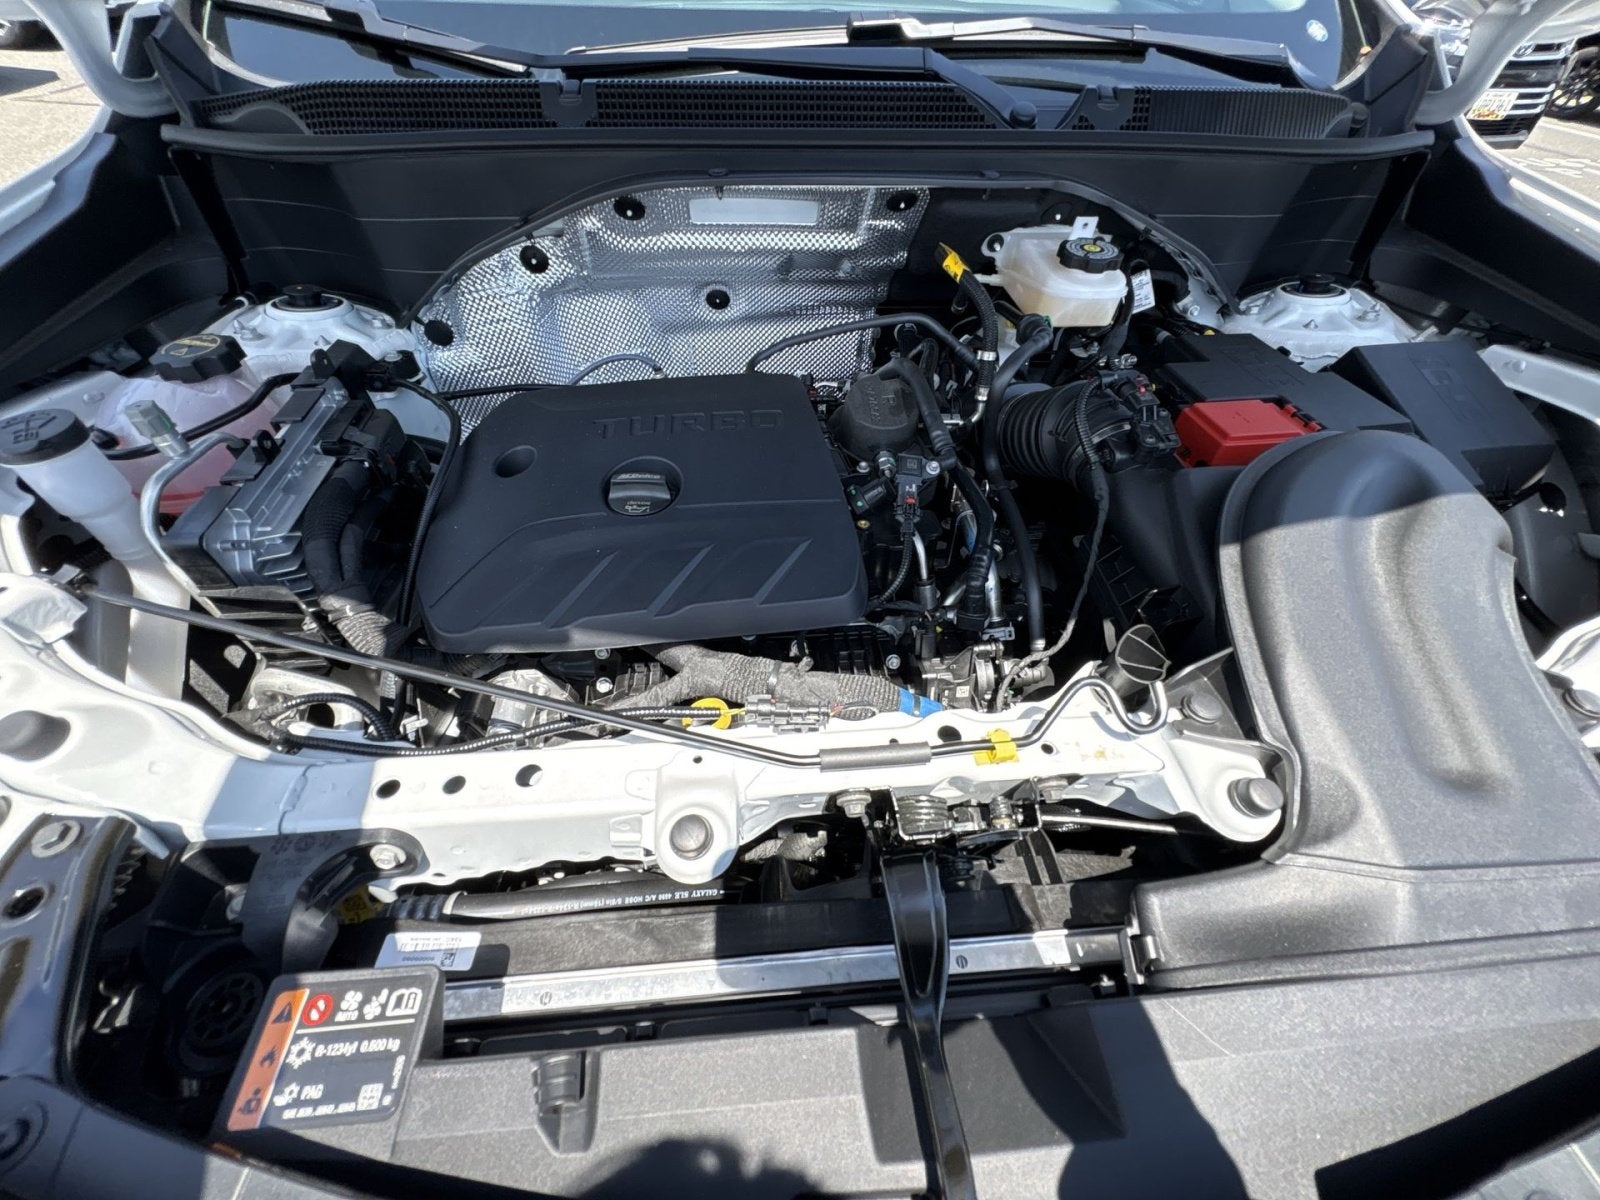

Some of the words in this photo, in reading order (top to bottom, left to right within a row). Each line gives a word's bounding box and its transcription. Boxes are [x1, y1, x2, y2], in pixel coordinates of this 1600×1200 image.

[592, 408, 784, 439] TURBO
[644, 894, 657, 903] A/C
[674, 890, 689, 900] SLE
[691, 888, 718, 898] GALAXY
[625, 896, 644, 905] HOSE
[334, 1010, 359, 1023] AUTO
[314, 1041, 358, 1058] R-1234yf
[386, 1037, 401, 1053] kg
[300, 1083, 324, 1100] PAG
